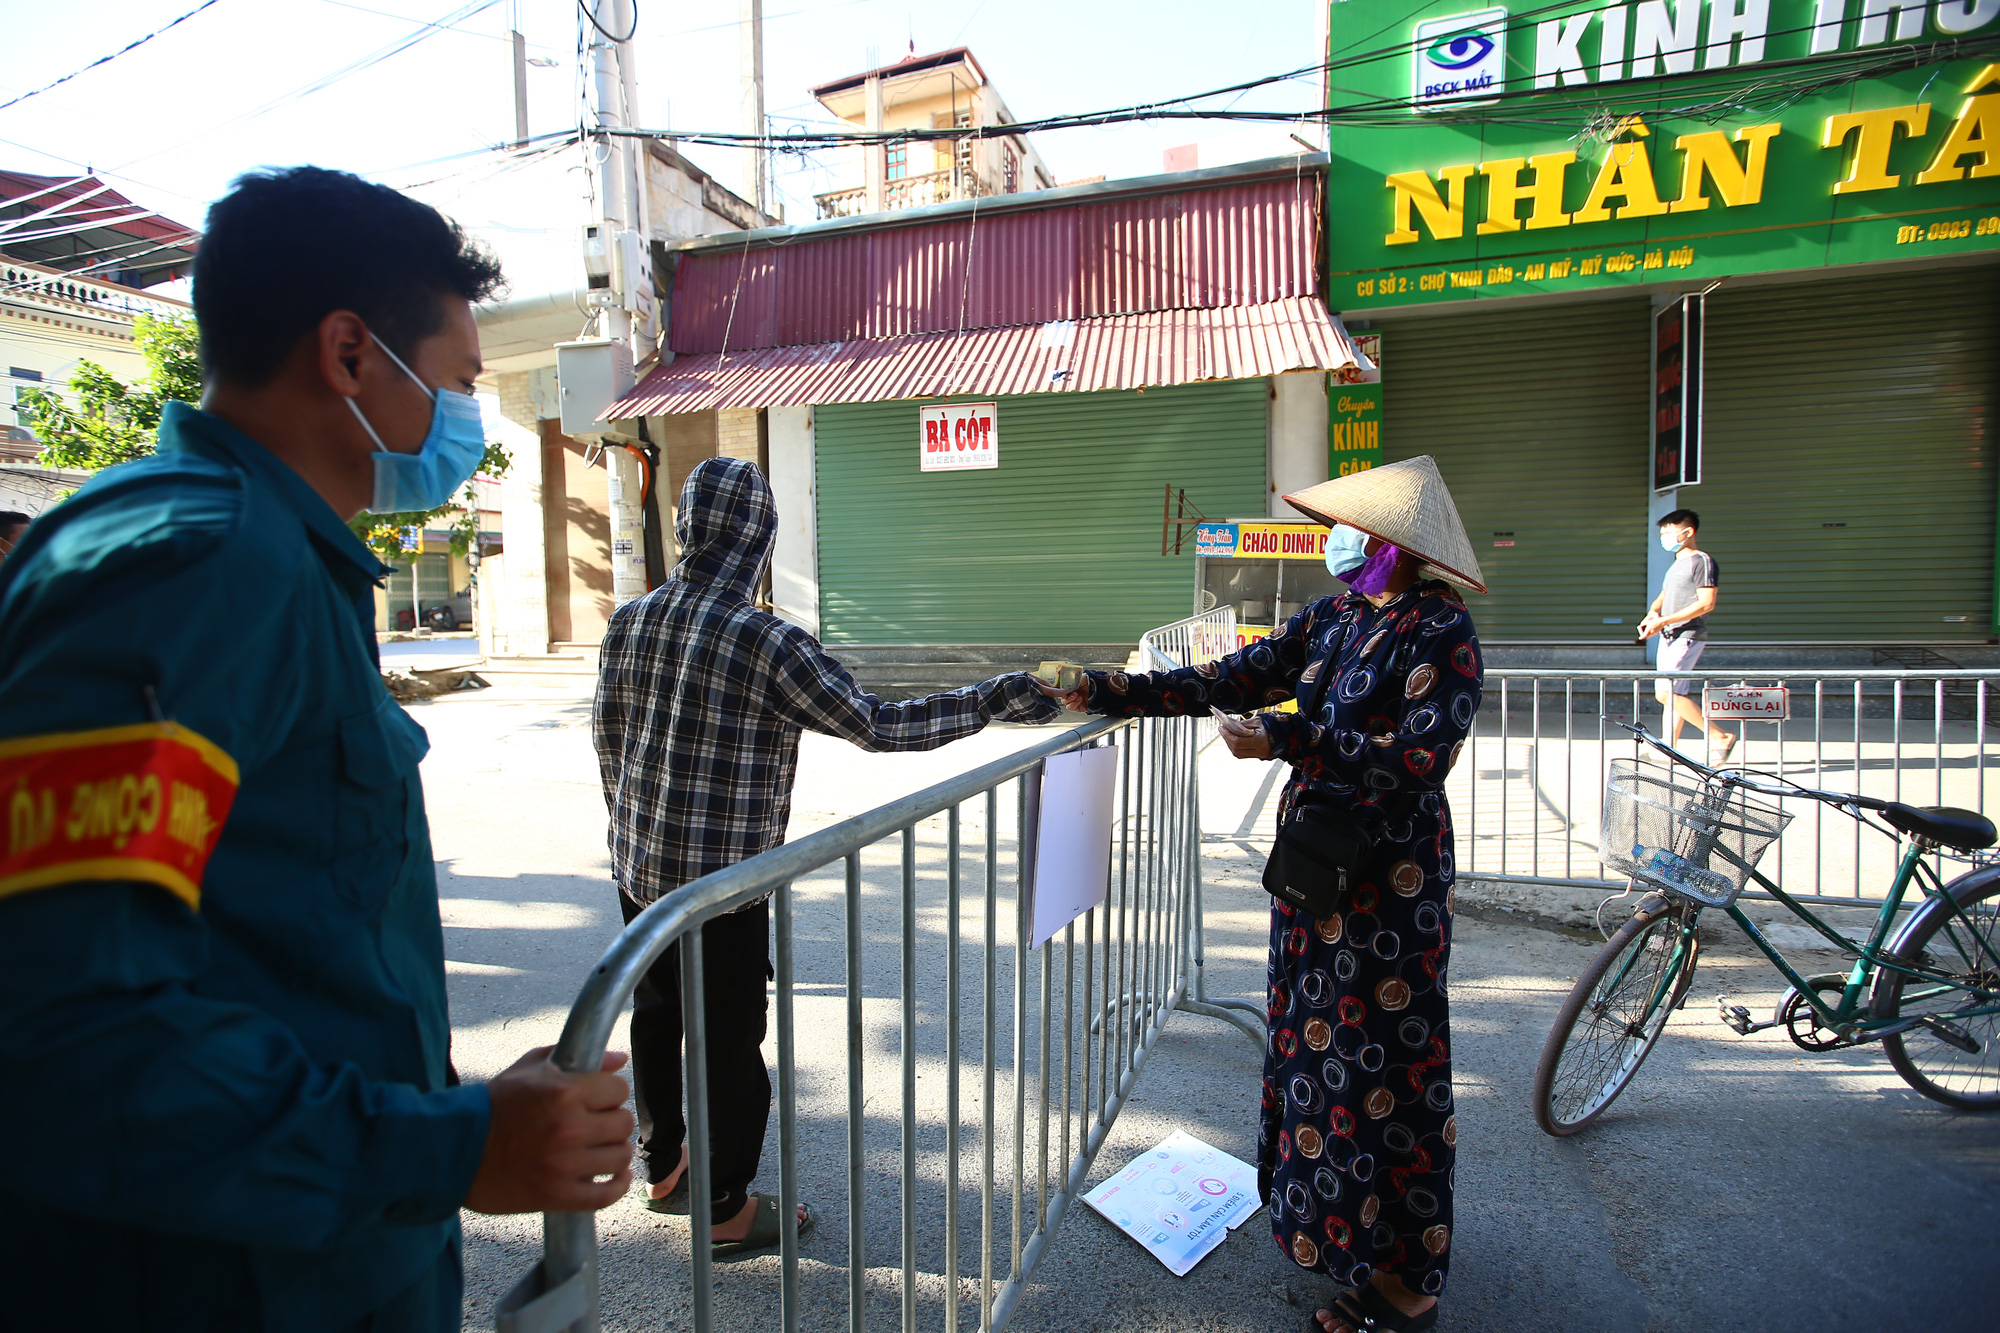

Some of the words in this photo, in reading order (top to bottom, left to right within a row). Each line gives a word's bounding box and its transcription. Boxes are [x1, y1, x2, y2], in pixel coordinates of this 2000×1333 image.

[1384, 115, 1782, 246] NHÂN
[1927, 220, 1971, 241] 0983
[1975, 216, 2000, 236] 99
[1357, 279, 1375, 297] CƠ
[1420, 271, 1446, 292] CHỢ
[1524, 263, 1545, 281] AN
[1643, 248, 1664, 270] HÀ
[1668, 245, 1694, 270] NỘI
[1338, 396, 1375, 418] Chuyên
[926, 412, 950, 453] BÀ
[955, 410, 990, 451] CÓT
[1333, 417, 1379, 451] KÍNH
[1242, 528, 1278, 553] CHÁO
[1282, 533, 1315, 554] DINH
[1711, 699, 1752, 711] DỪNG
[1755, 701, 1780, 713] LẠI
